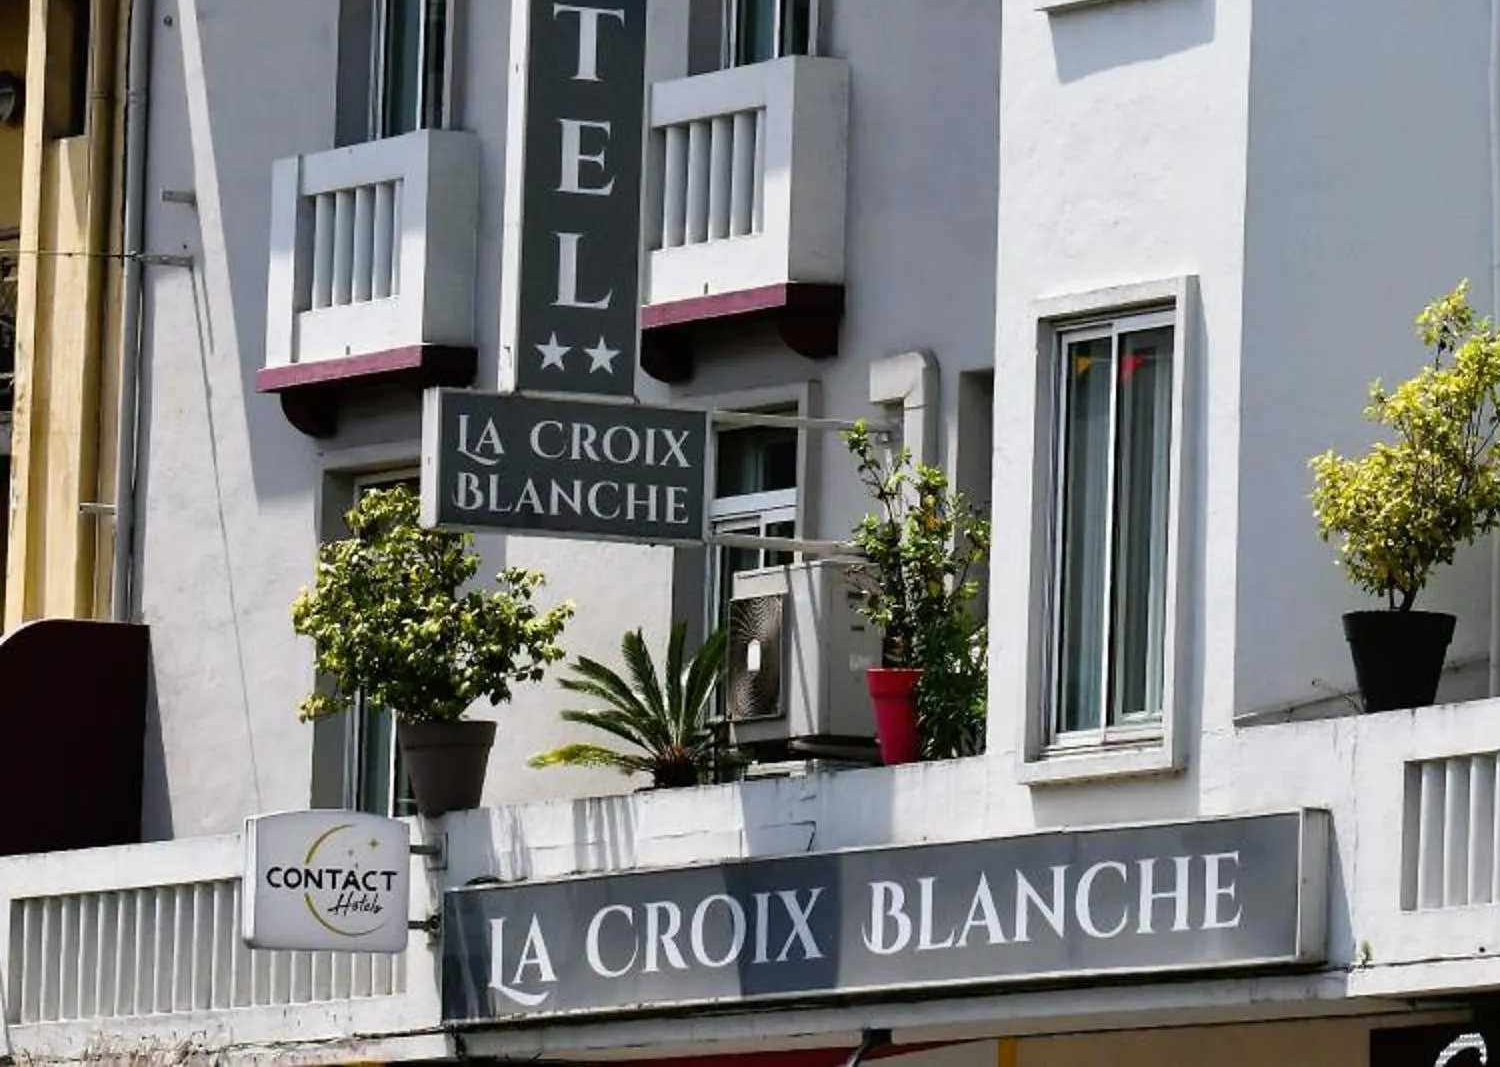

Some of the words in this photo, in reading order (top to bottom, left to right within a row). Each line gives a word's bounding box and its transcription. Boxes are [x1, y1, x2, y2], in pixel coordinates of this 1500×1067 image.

[456, 414, 505, 466] LA
[529, 419, 692, 468] CROIX
[453, 472, 690, 525] BLANCHE
[265, 865, 399, 893] CONTACT
[327, 890, 384, 917] Hotels
[487, 916, 558, 1007] LA
[585, 887, 826, 981] CROIX
[860, 849, 1244, 956] BLANCHE
